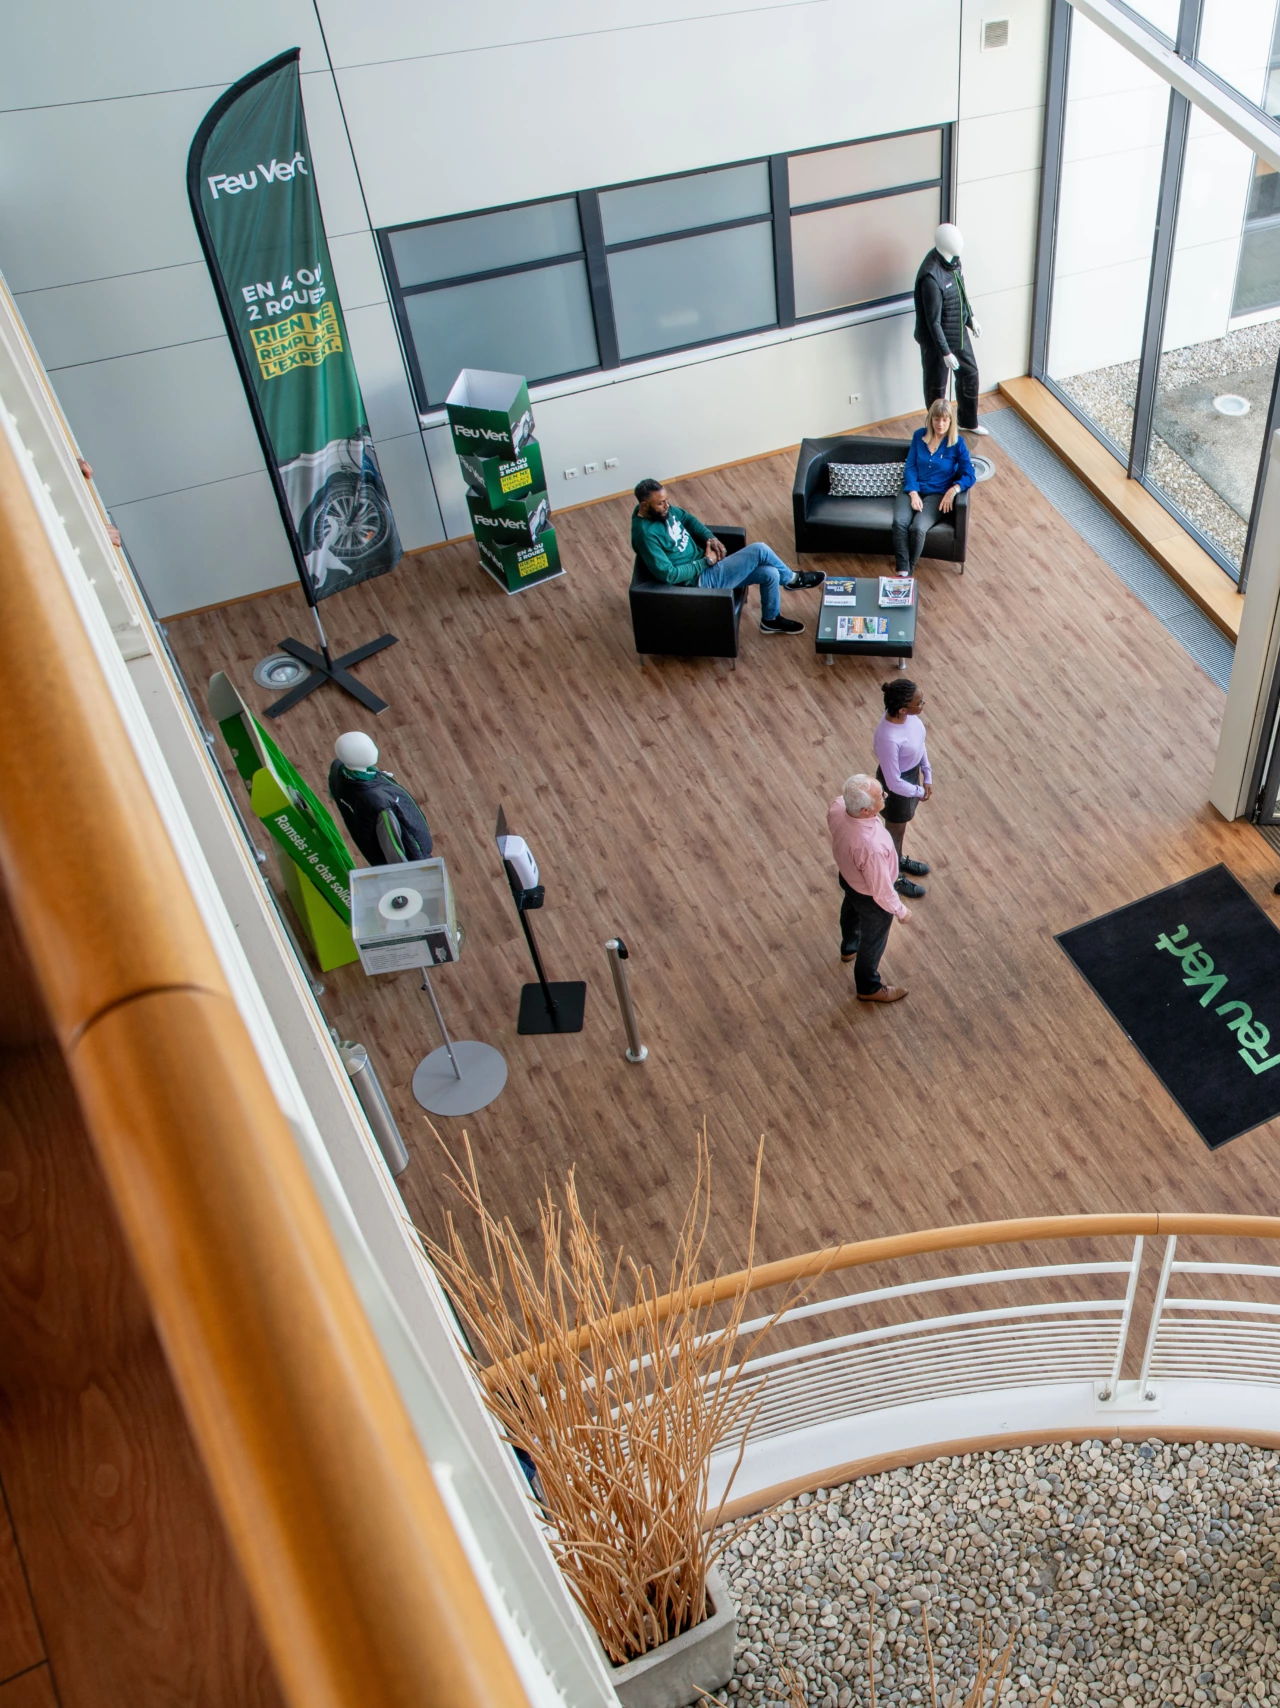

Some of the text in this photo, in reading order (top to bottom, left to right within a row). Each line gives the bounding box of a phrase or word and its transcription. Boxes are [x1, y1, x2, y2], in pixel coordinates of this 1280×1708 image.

[208, 152, 308, 199] Feu Vert
[242, 281, 275, 303] EN
[281, 275, 293, 291] 4
[247, 281, 326, 321] 2 ROUES
[253, 304, 332, 346] RIEN NE
[259, 323, 336, 361] REMPLACE
[454, 425, 510, 442] Feu Vert
[498, 464, 509, 472] EN
[517, 457, 527, 465] OU
[505, 462, 528, 475] ROUES
[474, 515, 527, 530] Feu Vert
[516, 549, 527, 558] EN
[523, 547, 545, 560] ROUES
[274, 814, 309, 851] Ramsès
[306, 852, 319, 864] le
[315, 863, 338, 884] chat
[330, 881, 352, 910] solida
[1154, 923, 1229, 1008] Vert
